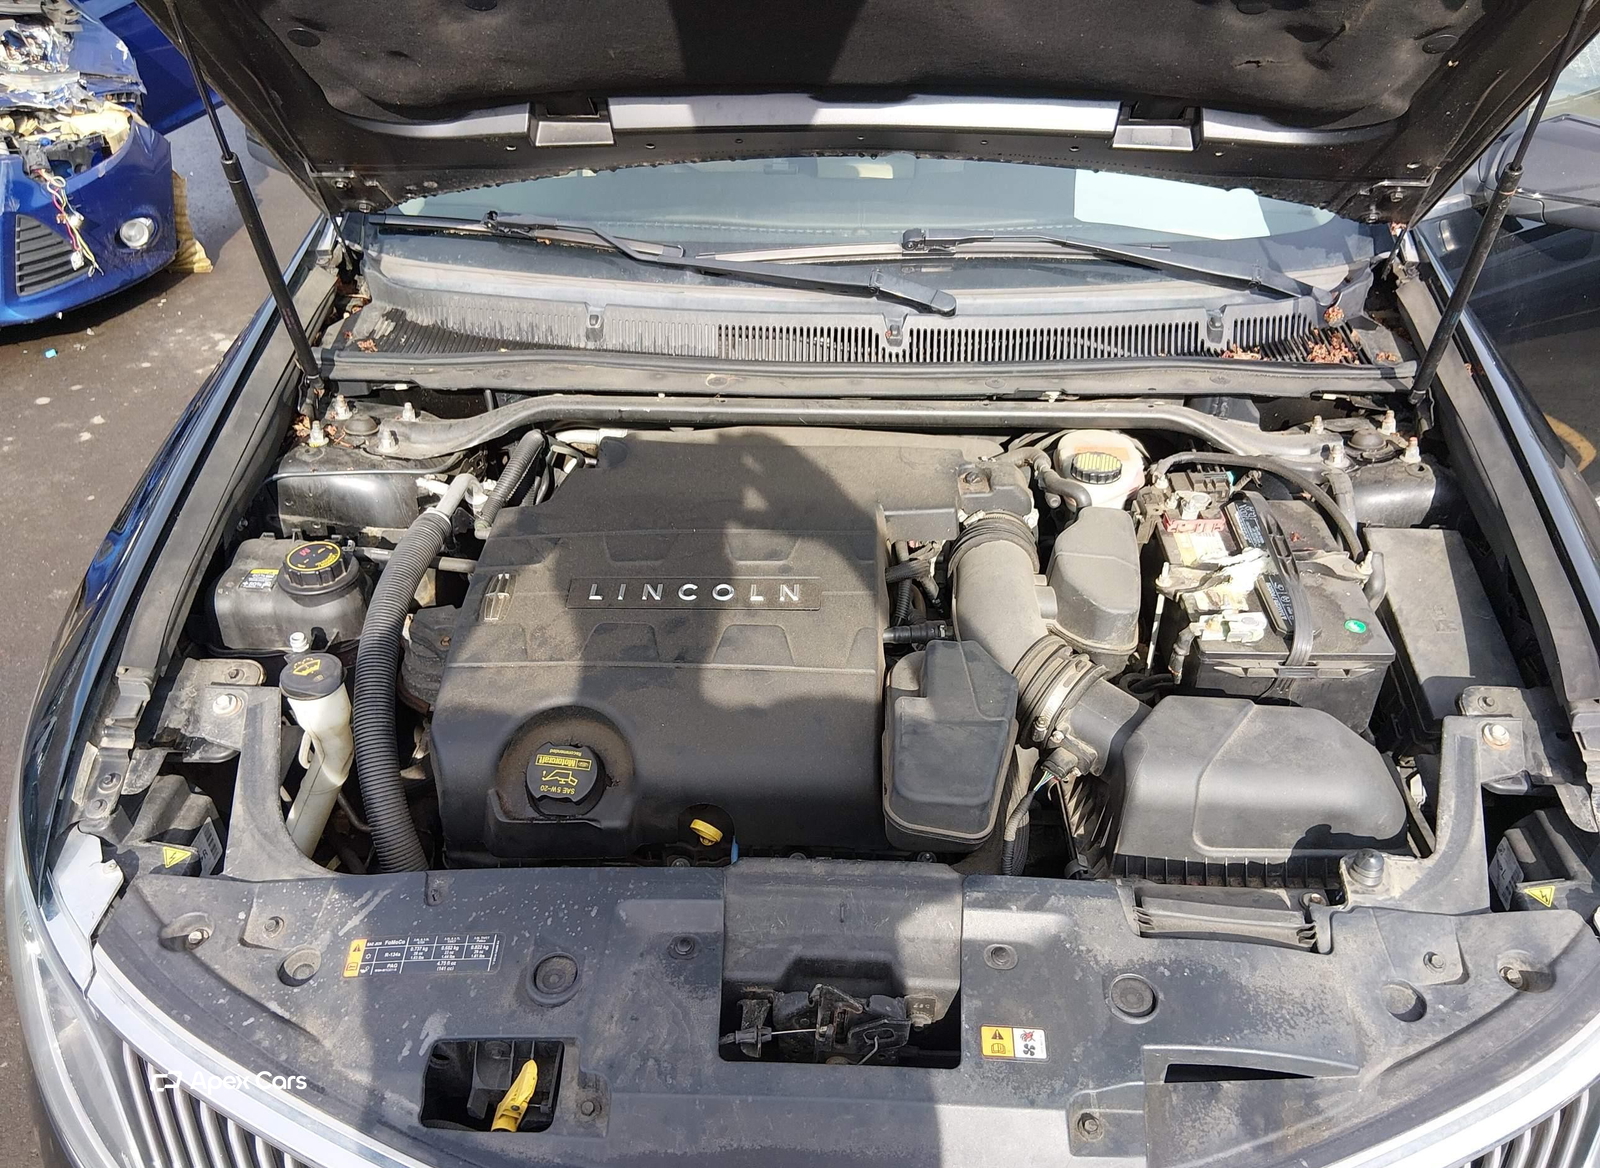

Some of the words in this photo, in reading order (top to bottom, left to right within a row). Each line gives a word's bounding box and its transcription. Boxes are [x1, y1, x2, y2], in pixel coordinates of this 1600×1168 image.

[588, 583, 800, 602] LINCOLN
[549, 748, 582, 756] Recommended
[538, 756, 576, 767] Motorcraft
[562, 786, 576, 794] SAE
